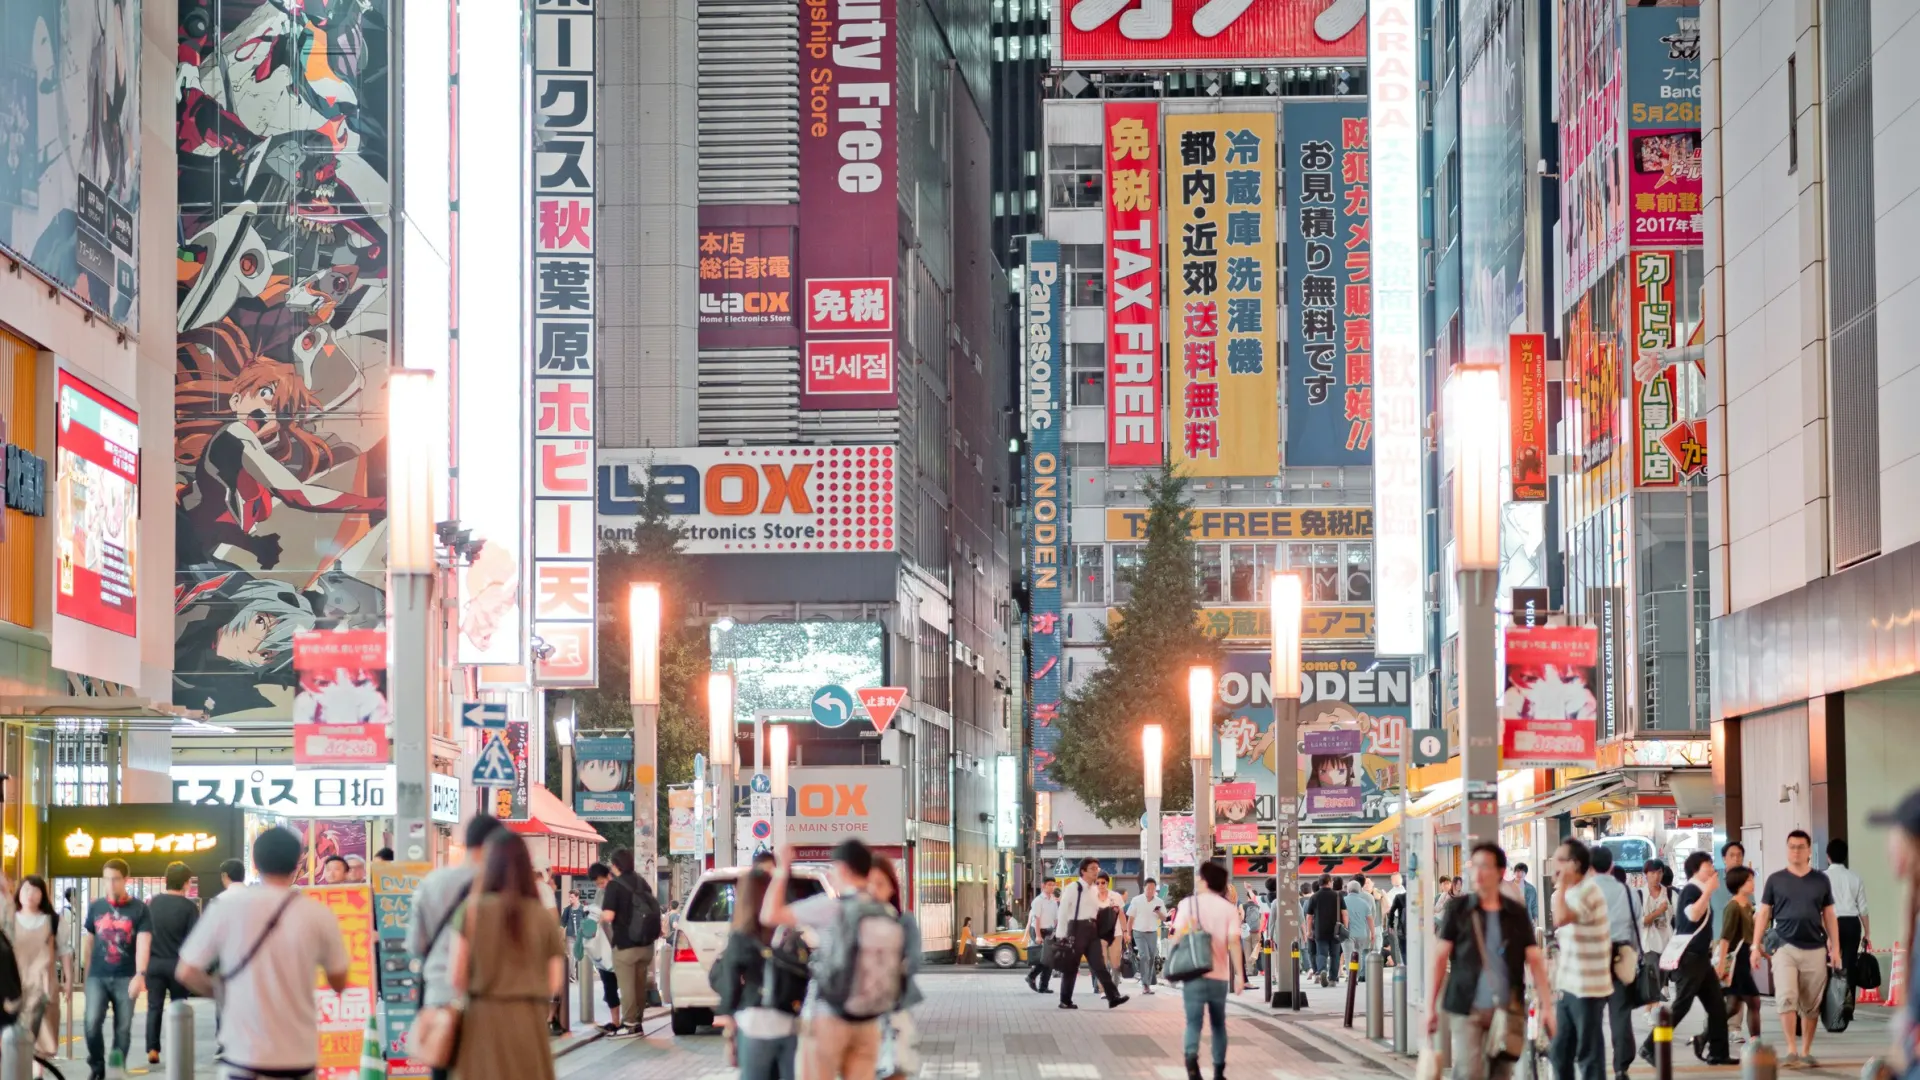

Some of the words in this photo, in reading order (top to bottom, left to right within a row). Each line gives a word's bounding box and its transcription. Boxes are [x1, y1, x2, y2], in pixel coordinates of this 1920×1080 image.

[1376, 7, 1410, 128] ARADA
[1662, 68, 1699, 80] ブース
[810, 68, 833, 138] Store
[837, 82, 891, 193] Free
[1111, 117, 1151, 212] 免税
[1635, 193, 1703, 212] 事前登
[700, 231, 745, 254] 本店
[700, 255, 790, 278] 総合家電
[1113, 219, 1152, 312] TAX
[1300, 140, 1337, 405] お見積り無料です
[812, 288, 885, 322] 免税
[539, 0, 592, 681] ークス秋葉原ホビー天国
[1029, 260, 1058, 431] Panasonic
[811, 354, 887, 380] 면세점
[1113, 323, 1154, 444] FREE
[1639, 255, 1672, 481] カードゲム専門店
[763, 522, 815, 540] Store
[1033, 452, 1058, 590] ONODEN
[1203, 511, 1293, 537] FREE
[1340, 659, 1357, 671] to
[866, 696, 897, 707] 止まれ
[798, 824, 828, 832] MAIN
[831, 823, 869, 832] STORE
